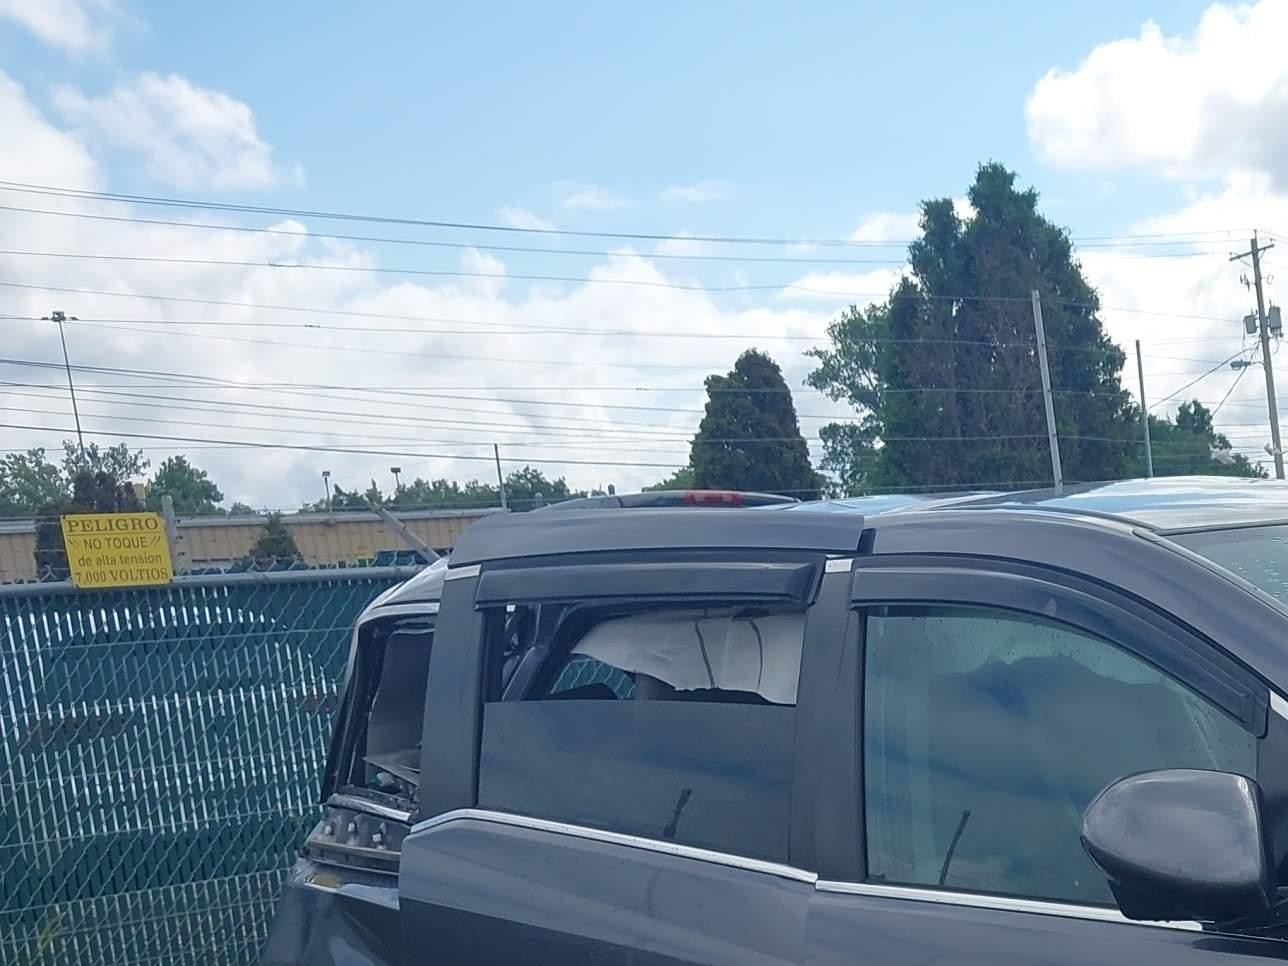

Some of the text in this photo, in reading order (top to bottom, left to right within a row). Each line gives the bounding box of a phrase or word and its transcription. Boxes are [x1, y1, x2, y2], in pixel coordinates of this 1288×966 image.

[67, 517, 159, 533] PELIGRO
[84, 536, 149, 550] NO TOQUE
[78, 553, 162, 567] de alta tension
[109, 567, 168, 582] VOLTIOS
